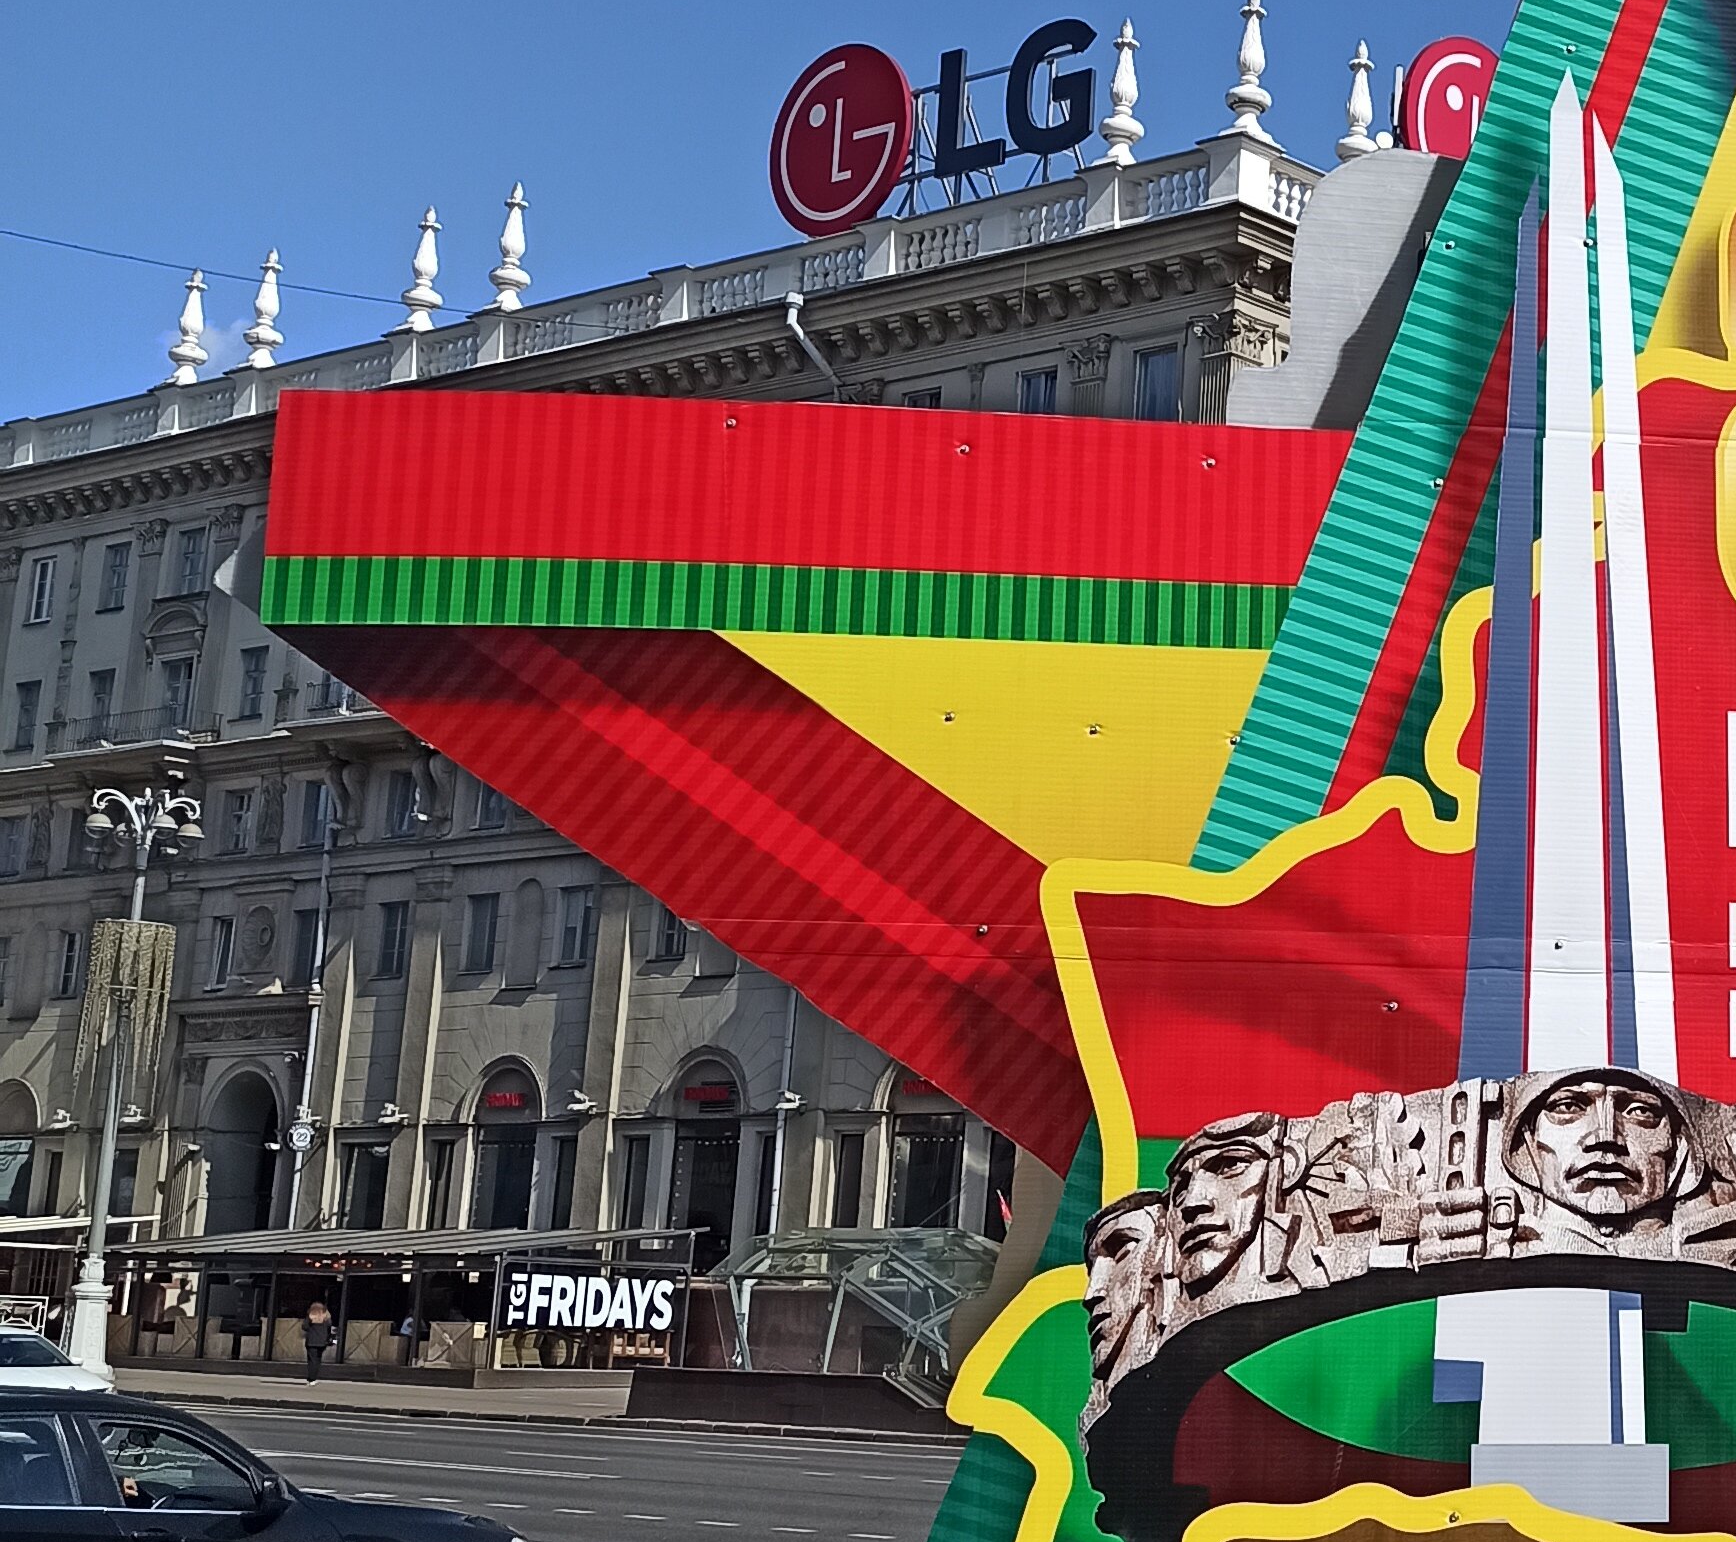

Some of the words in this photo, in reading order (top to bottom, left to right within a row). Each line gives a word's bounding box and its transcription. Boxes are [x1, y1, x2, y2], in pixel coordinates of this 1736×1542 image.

[934, 18, 1098, 179] LG
[507, 1273, 528, 1325] TGI
[527, 1274, 675, 1330] FRIDAYS
